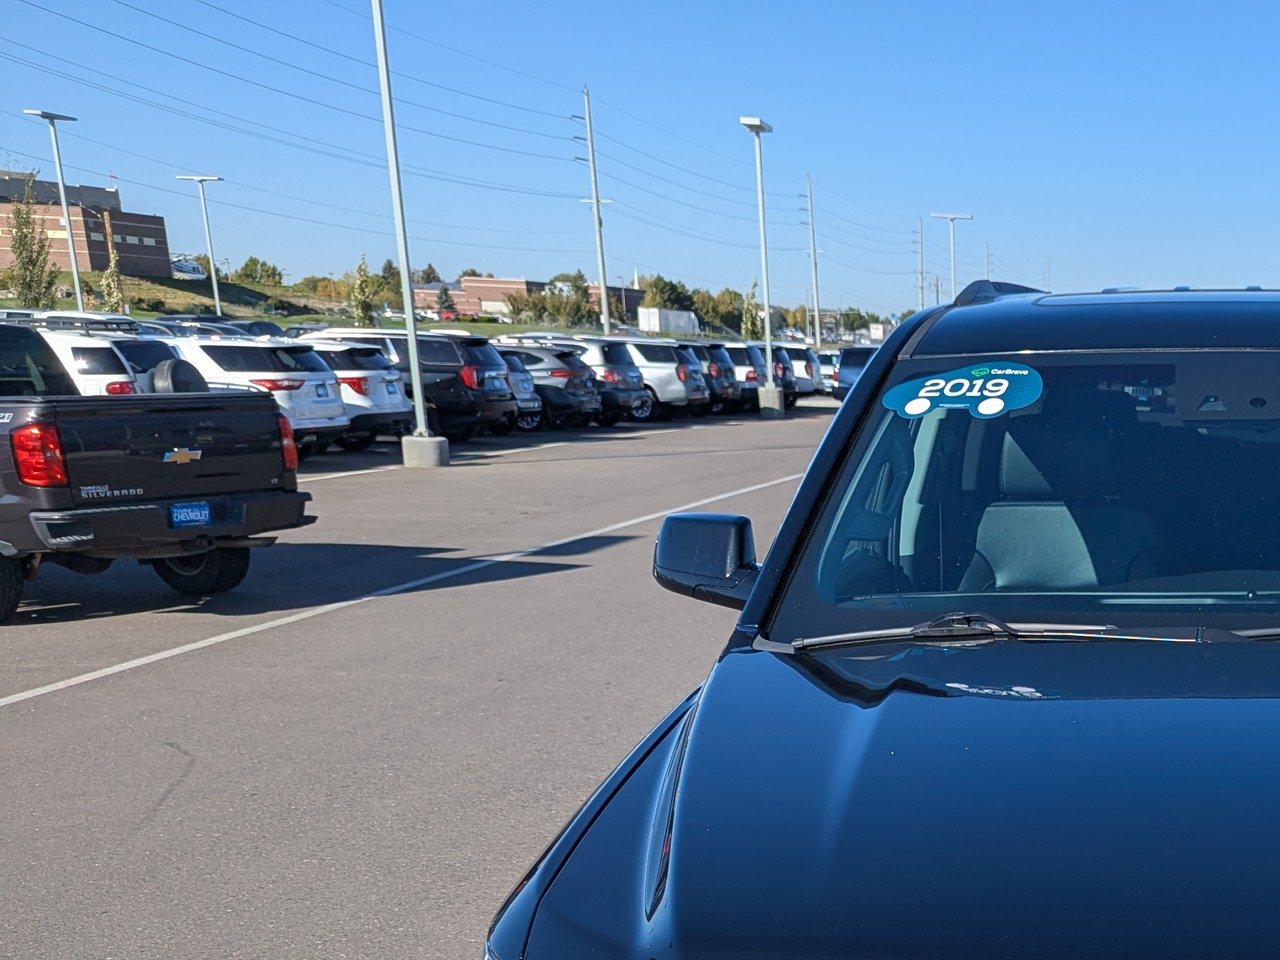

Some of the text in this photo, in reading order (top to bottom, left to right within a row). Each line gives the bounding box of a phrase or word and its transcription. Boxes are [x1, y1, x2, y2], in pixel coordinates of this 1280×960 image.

[990, 368, 1029, 376] CarBravo
[917, 378, 1010, 397] 2019
[80, 488, 144, 499] SILVERADO
[173, 511, 209, 522] CHEVROLET
